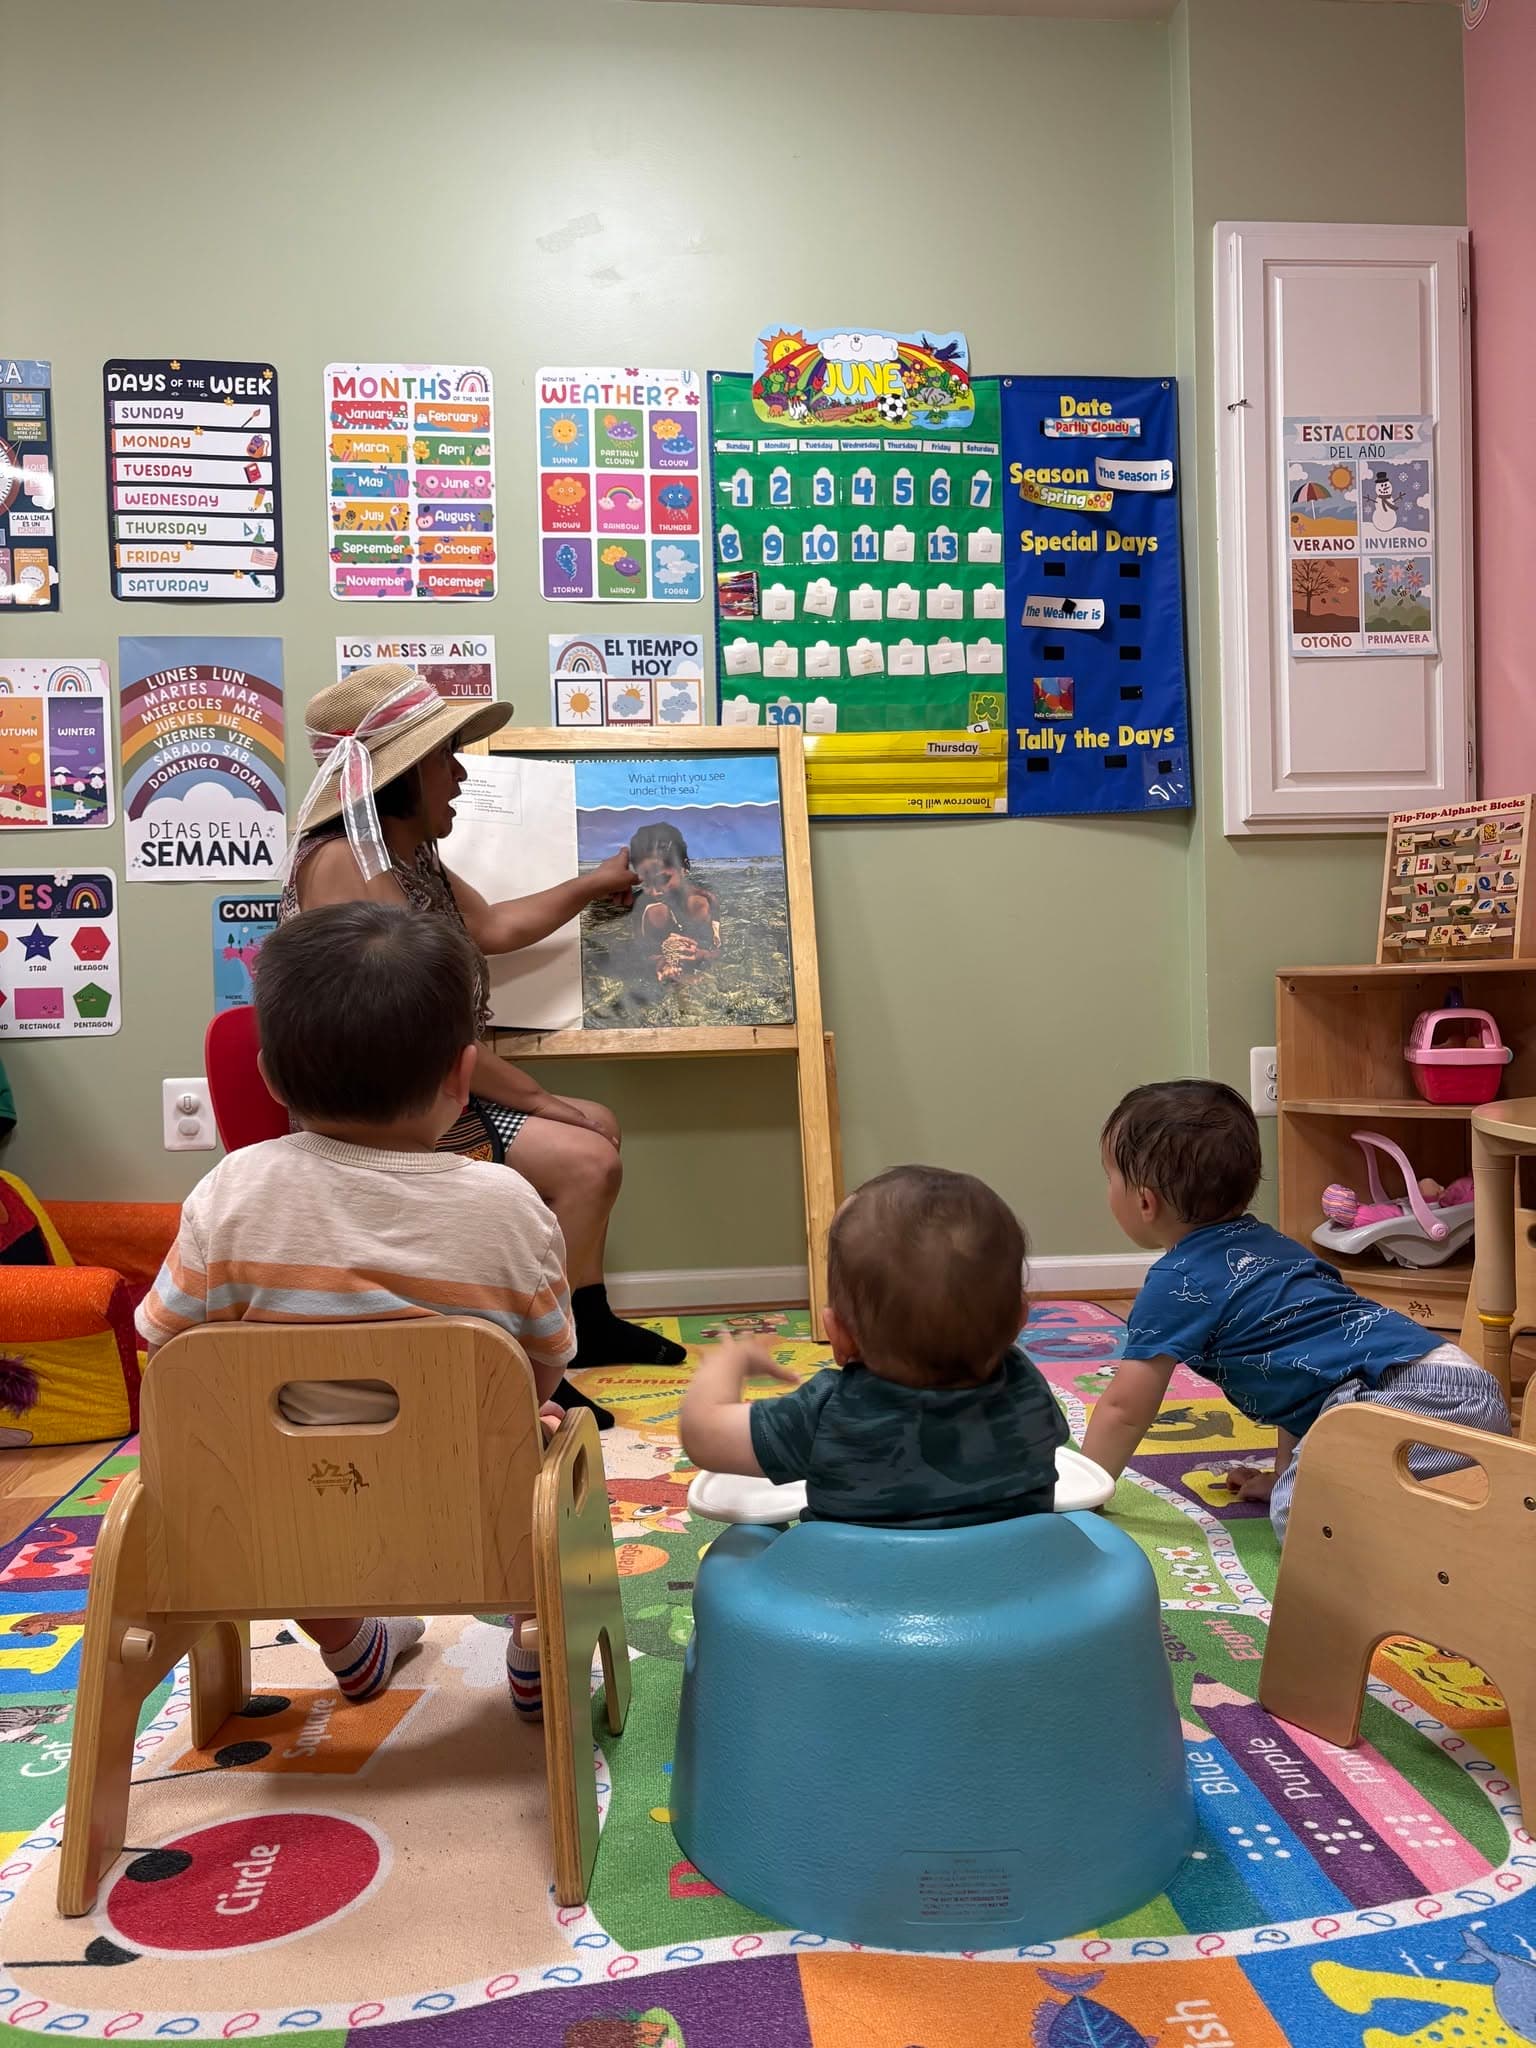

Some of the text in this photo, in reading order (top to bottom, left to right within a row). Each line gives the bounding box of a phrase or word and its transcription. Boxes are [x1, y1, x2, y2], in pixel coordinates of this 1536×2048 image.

[108, 374, 272, 396] DAYS OF THE WEEK
[822, 362, 902, 397] JUNE
[333, 377, 452, 400] MONTHS
[541, 384, 680, 406] WEATHER?
[121, 407, 185, 420] SUNDAY
[1059, 395, 1113, 418] Date
[346, 408, 394, 421] January
[428, 410, 478, 423] February
[1054, 421, 1129, 434] Partly Cloudy
[1303, 424, 1415, 442] ESTACIONES
[122, 435, 192, 449] MONDAY
[352, 443, 391, 453] March
[726, 443, 750, 452] Sunday
[764, 441, 791, 451] Monday
[804, 441, 833, 451] Tuesday
[842, 441, 880, 451] Wednesday
[887, 441, 918, 452] Thursday
[931, 442, 952, 452] Friday
[966, 444, 995, 454] Saturday
[438, 444, 465, 456] April
[600, 449, 639, 458] PARTIALLY
[1330, 442, 1386, 459] DEL AÑO
[552, 457, 579, 465] SUNNY
[604, 458, 635, 466] CLOUDY
[659, 459, 690, 467] CLOUDY
[123, 464, 193, 477] TUESDAY
[1009, 462, 1090, 484] Season
[1098, 467, 1116, 481] The
[1160, 469, 1170, 481] is
[358, 476, 384, 488] May
[440, 477, 471, 488] June
[737, 479, 748, 505] 1
[773, 477, 788, 505] 2
[816, 478, 832, 505] 3
[853, 477, 874, 504] 4
[896, 477, 912, 504] 5
[932, 478, 949, 504] 6
[973, 479, 990, 505] 7
[124, 492, 220, 507] WEDNESDAY
[1040, 487, 1087, 510] Spring
[359, 510, 385, 522] July
[434, 510, 477, 523] August
[125, 522, 208, 536] THURSDAY
[602, 523, 640, 531] RAINBOW
[658, 524, 692, 532] THUNDER
[342, 543, 405, 556] September
[434, 543, 482, 554] October
[721, 534, 739, 560] 8
[764, 534, 781, 560] 9
[805, 534, 836, 560] 10
[853, 534, 878, 560] 11
[930, 534, 958, 560] 13
[1020, 529, 1160, 557] Special Days
[1293, 538, 1355, 552] VERANO
[1365, 537, 1428, 550] INVIERNO
[126, 550, 181, 563] FRIDAY
[128, 579, 209, 592] SATURDAY
[346, 575, 407, 586] November
[428, 575, 486, 587] December
[552, 586, 584, 594] STORMY
[609, 586, 636, 595] WINDY
[664, 587, 689, 596] FOGGY
[1026, 605, 1040, 618] The
[1091, 608, 1101, 620] is
[1301, 633, 1353, 648] OTOÑO
[1367, 633, 1430, 645] PRIMAVERA
[343, 639, 488, 659] LOS MESES del AÑO
[604, 640, 698, 658] EL TIEMPO
[631, 660, 672, 676] HOY
[146, 667, 249, 691] LUNES LUN.
[143, 682, 262, 708] MARTES MAR.
[451, 684, 492, 697] JULIO
[768, 704, 802, 727] 30
[154, 712, 243, 735] JUEVES JUE.
[0, 727, 38, 737] UTUMN
[57, 727, 96, 737] WINTER
[153, 727, 254, 751] VIERNES VIE.
[1016, 724, 1176, 754] Tally the Days
[927, 743, 979, 756] Thursday
[148, 758, 263, 793] DOMINGO DOM.
[629, 772, 726, 786] What might you see
[629, 784, 700, 797] under the sea?
[908, 799, 991, 808] Tomorrow will be:
[1394, 799, 1526, 825] Flip-Flop-Alphabet Blocks
[149, 820, 262, 839] DÍAS DE LA
[141, 840, 274, 867] SEMANA
[1418, 858, 1429, 870] H
[1416, 882, 1428, 895] N
[1457, 878, 1468, 892] P
[1479, 876, 1492, 891] Q
[29, 965, 48, 973] STAR
[73, 965, 110, 973] HEXAGON
[19, 1023, 62, 1031] RECTANGLE
[73, 1021, 114, 1029] PENTAGON
[597, 1387, 690, 1405] Decemb
[283, 1697, 338, 1760] Square
[1187, 1751, 1240, 1797] Blue
[1247, 1737, 1323, 1801] Purple
[215, 1842, 282, 1918] Circle
[1166, 1999, 1236, 2048] ish
